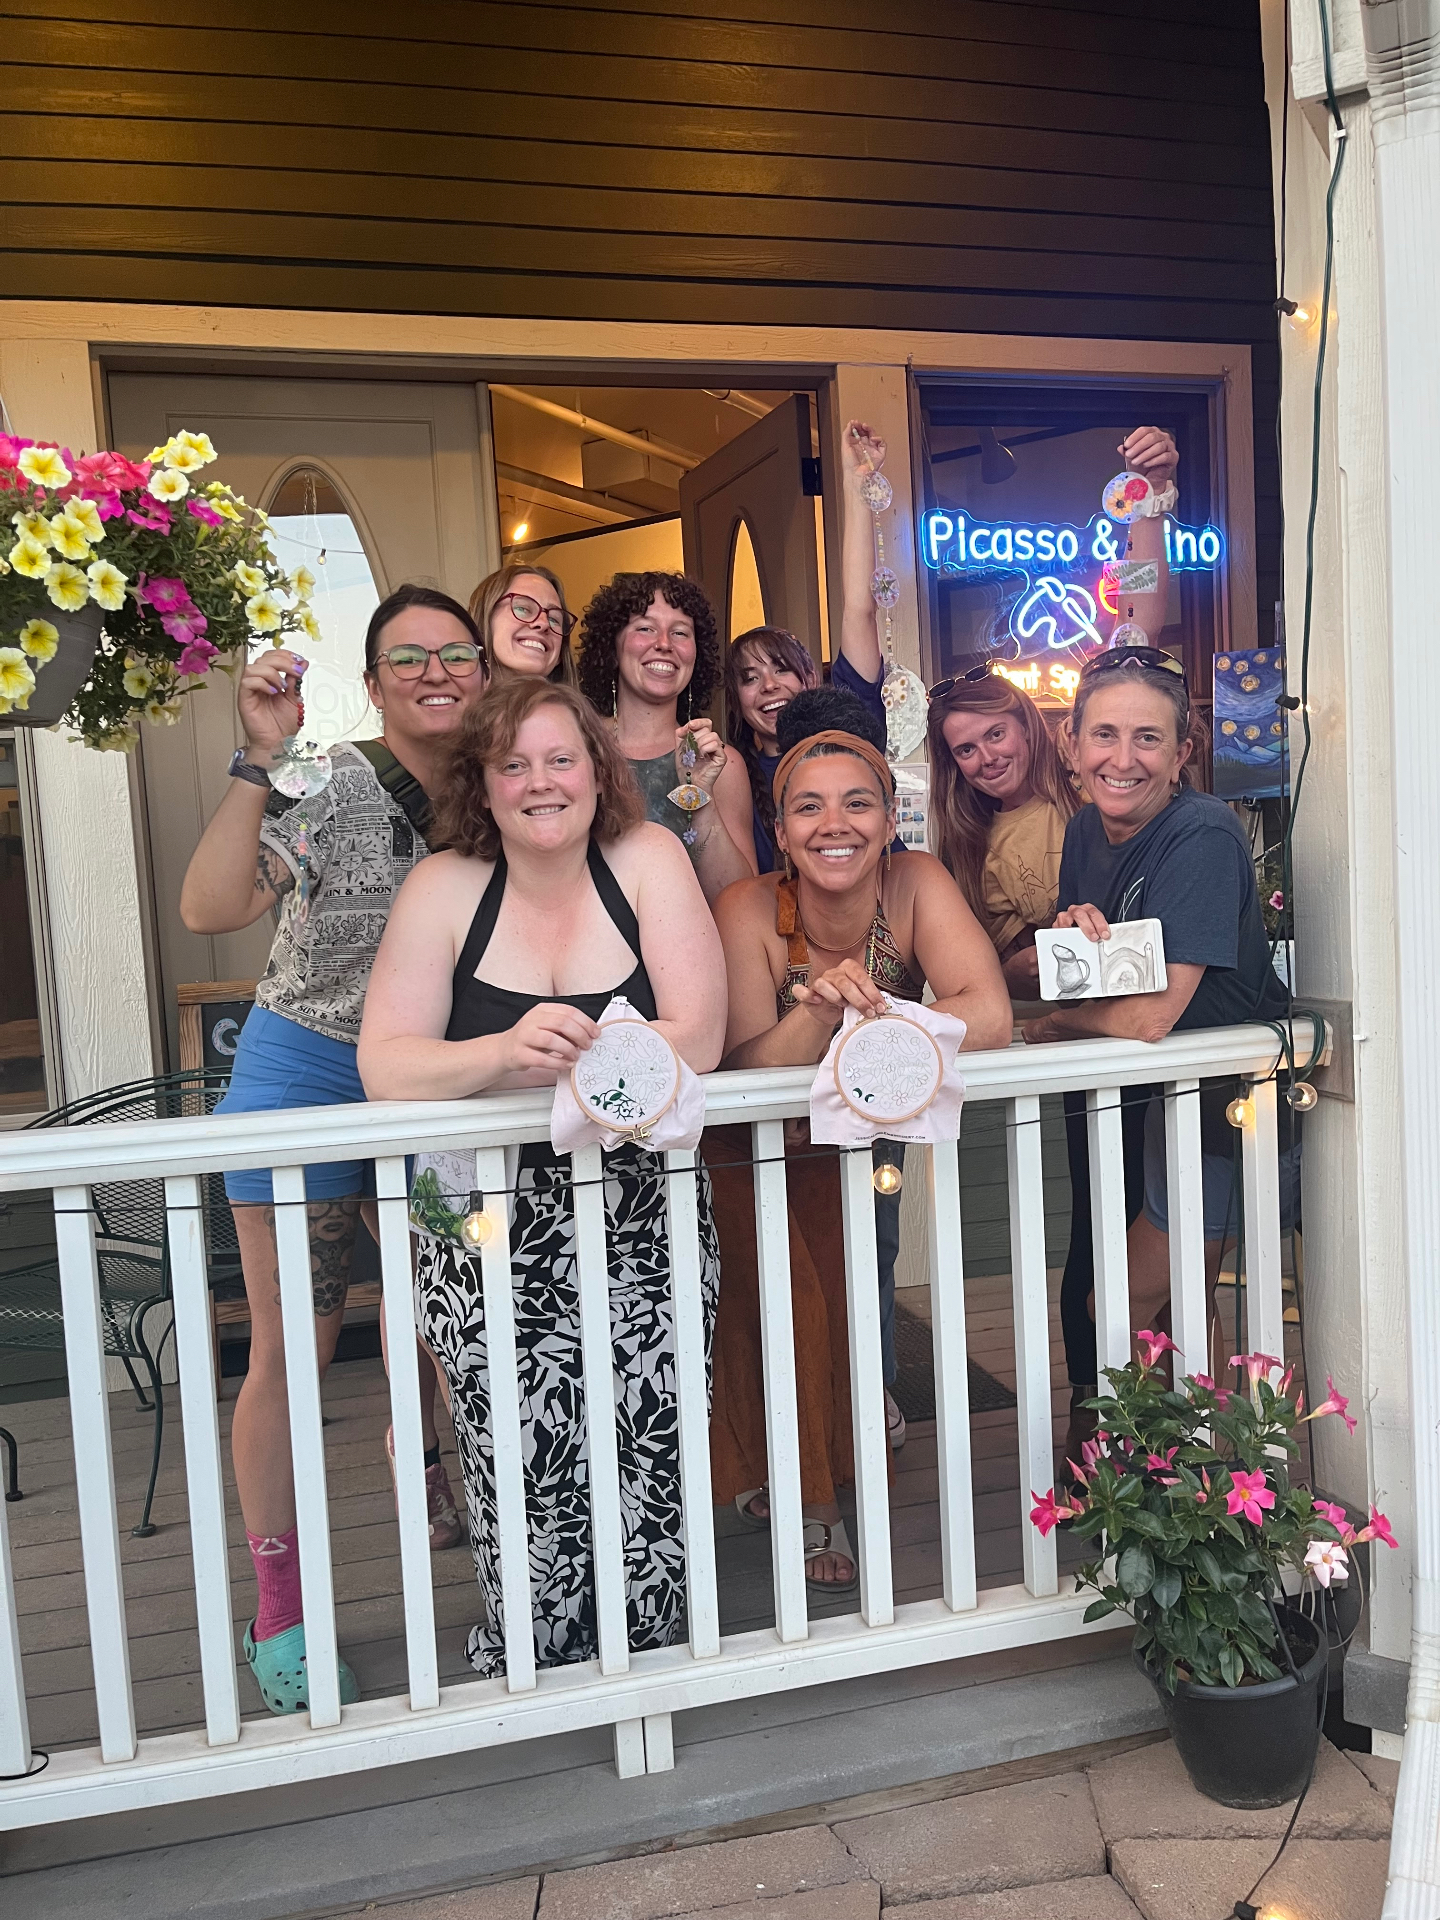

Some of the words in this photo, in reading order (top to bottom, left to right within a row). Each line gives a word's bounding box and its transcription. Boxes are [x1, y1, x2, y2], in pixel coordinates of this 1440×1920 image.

[929, 515, 1079, 563] Picasso
[1091, 518, 1119, 562] &
[1163, 519, 1221, 563] ino
[345, 887, 354, 896] &
[360, 885, 392, 895] MOON
[297, 1004, 318, 1016] SUN
[319, 1012, 328, 1020] &
